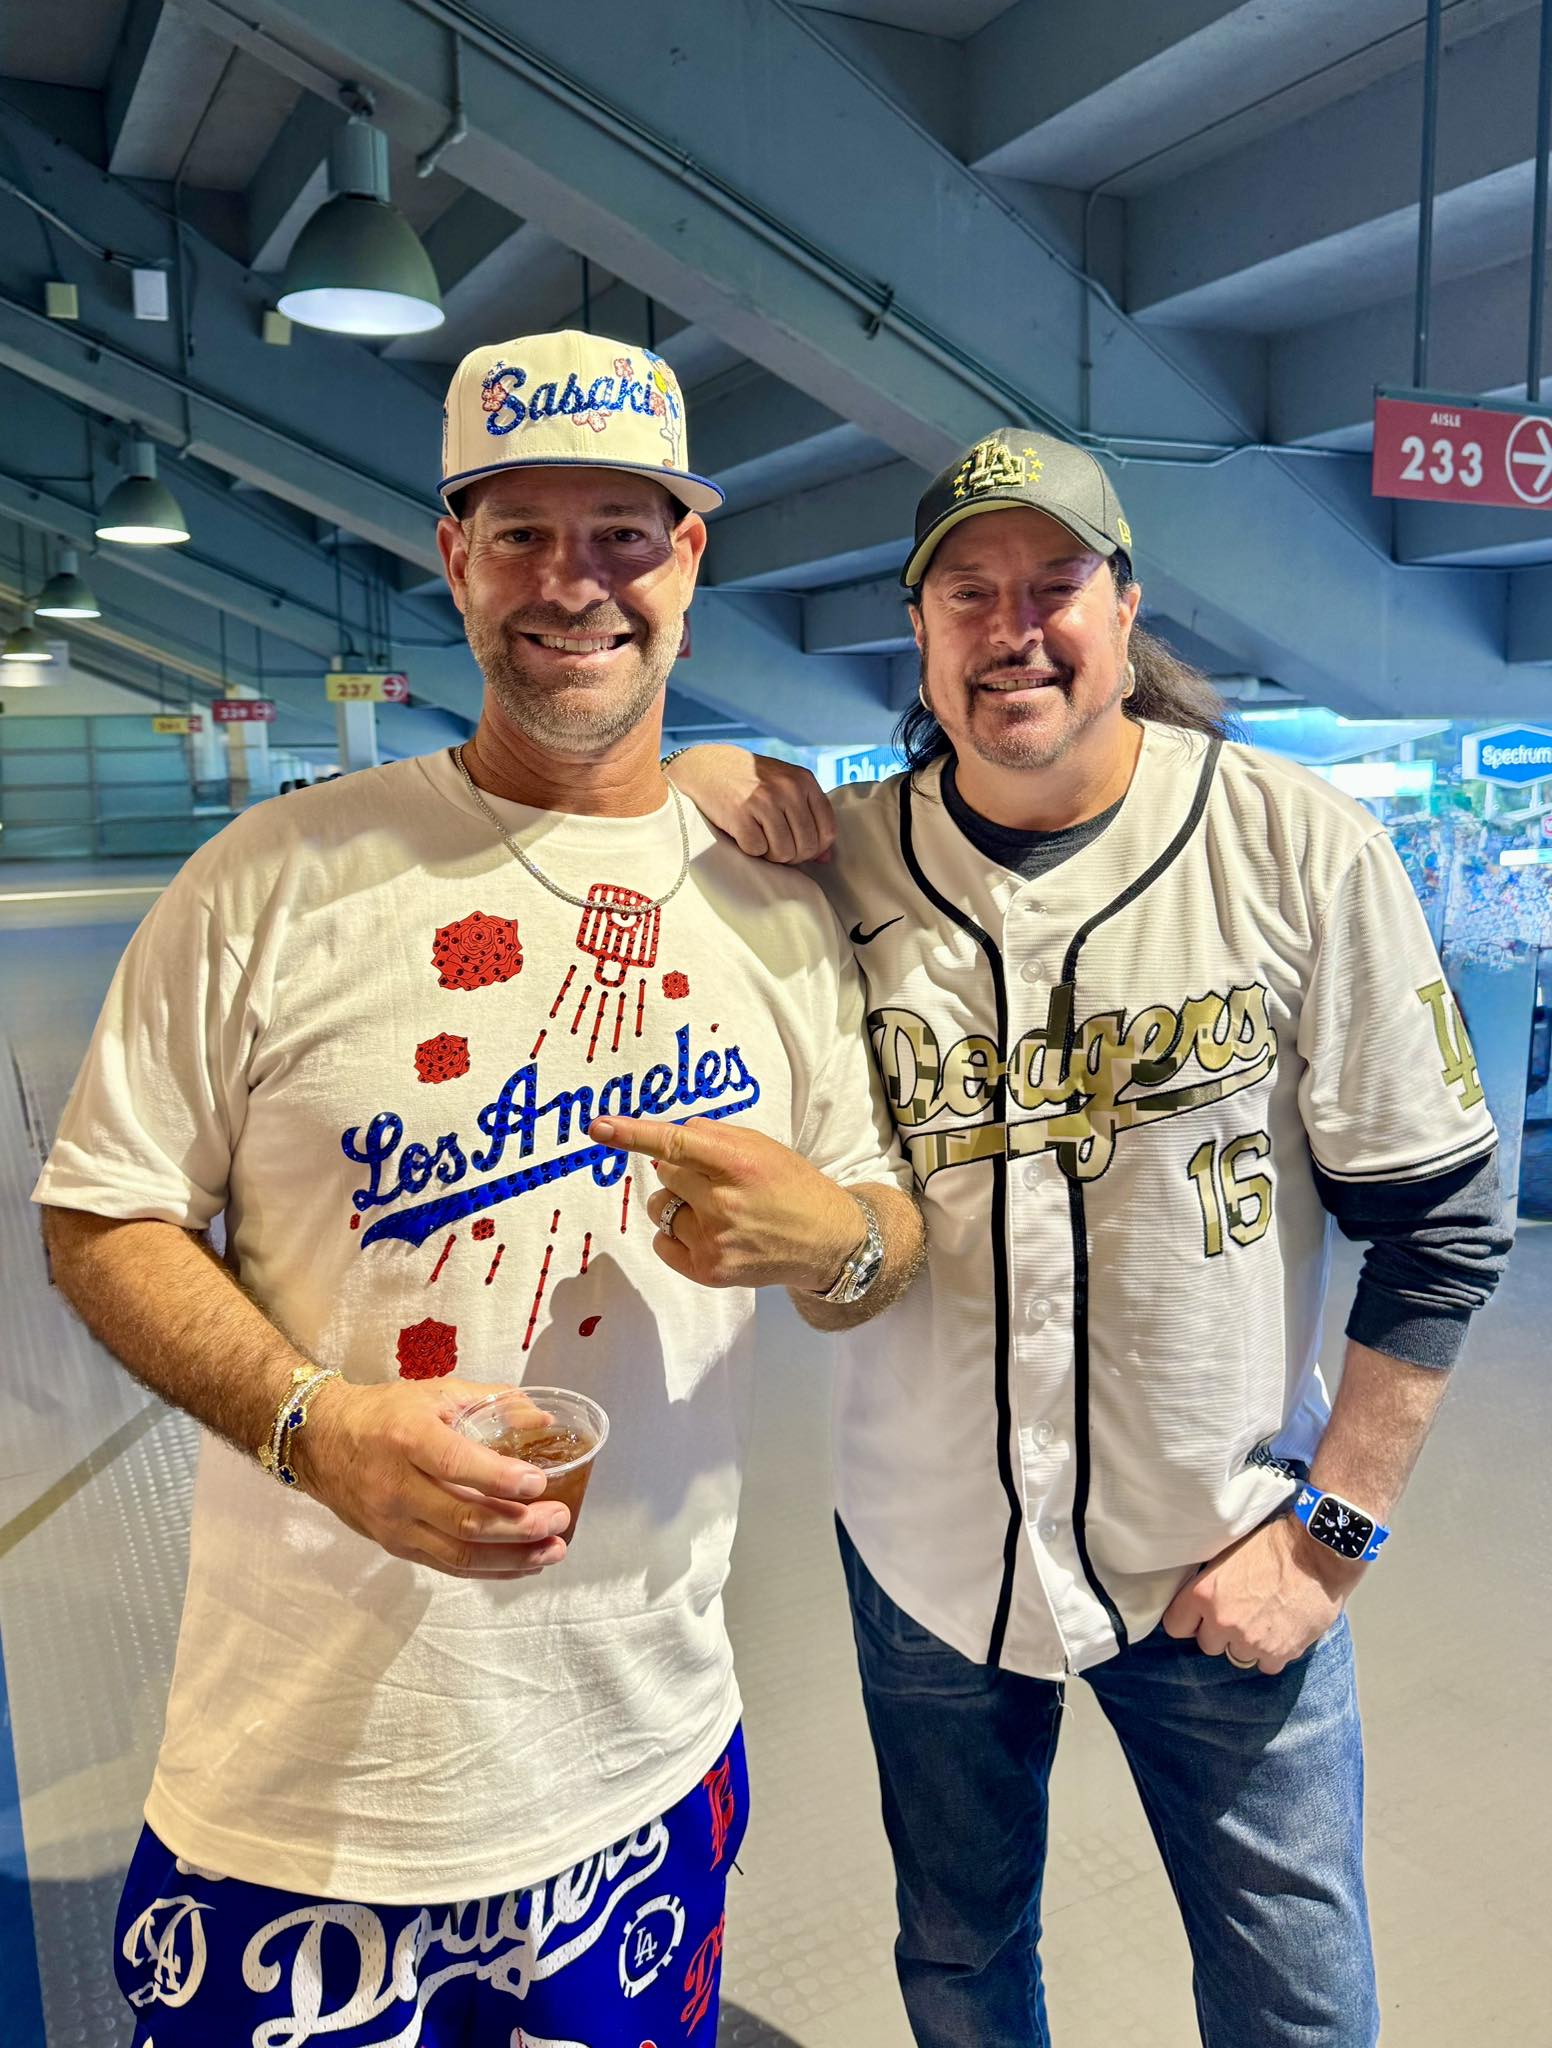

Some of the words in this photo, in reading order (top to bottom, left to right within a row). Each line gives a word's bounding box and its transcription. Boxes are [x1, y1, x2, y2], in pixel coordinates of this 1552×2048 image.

[484, 366, 656, 436] Sasaki
[1430, 412, 1461, 427] AISLE
[968, 438, 1026, 495] LA
[1400, 435, 1483, 488] 233
[336, 683, 371, 698] 237
[1482, 745, 1552, 769] Spectrum
[868, 981, 1278, 1182] Dodgers
[341, 1111, 468, 1211] Los
[471, 1023, 761, 1187] Angeles
[1187, 1129, 1271, 1258] 16
[633, 1926, 658, 1968] LA
